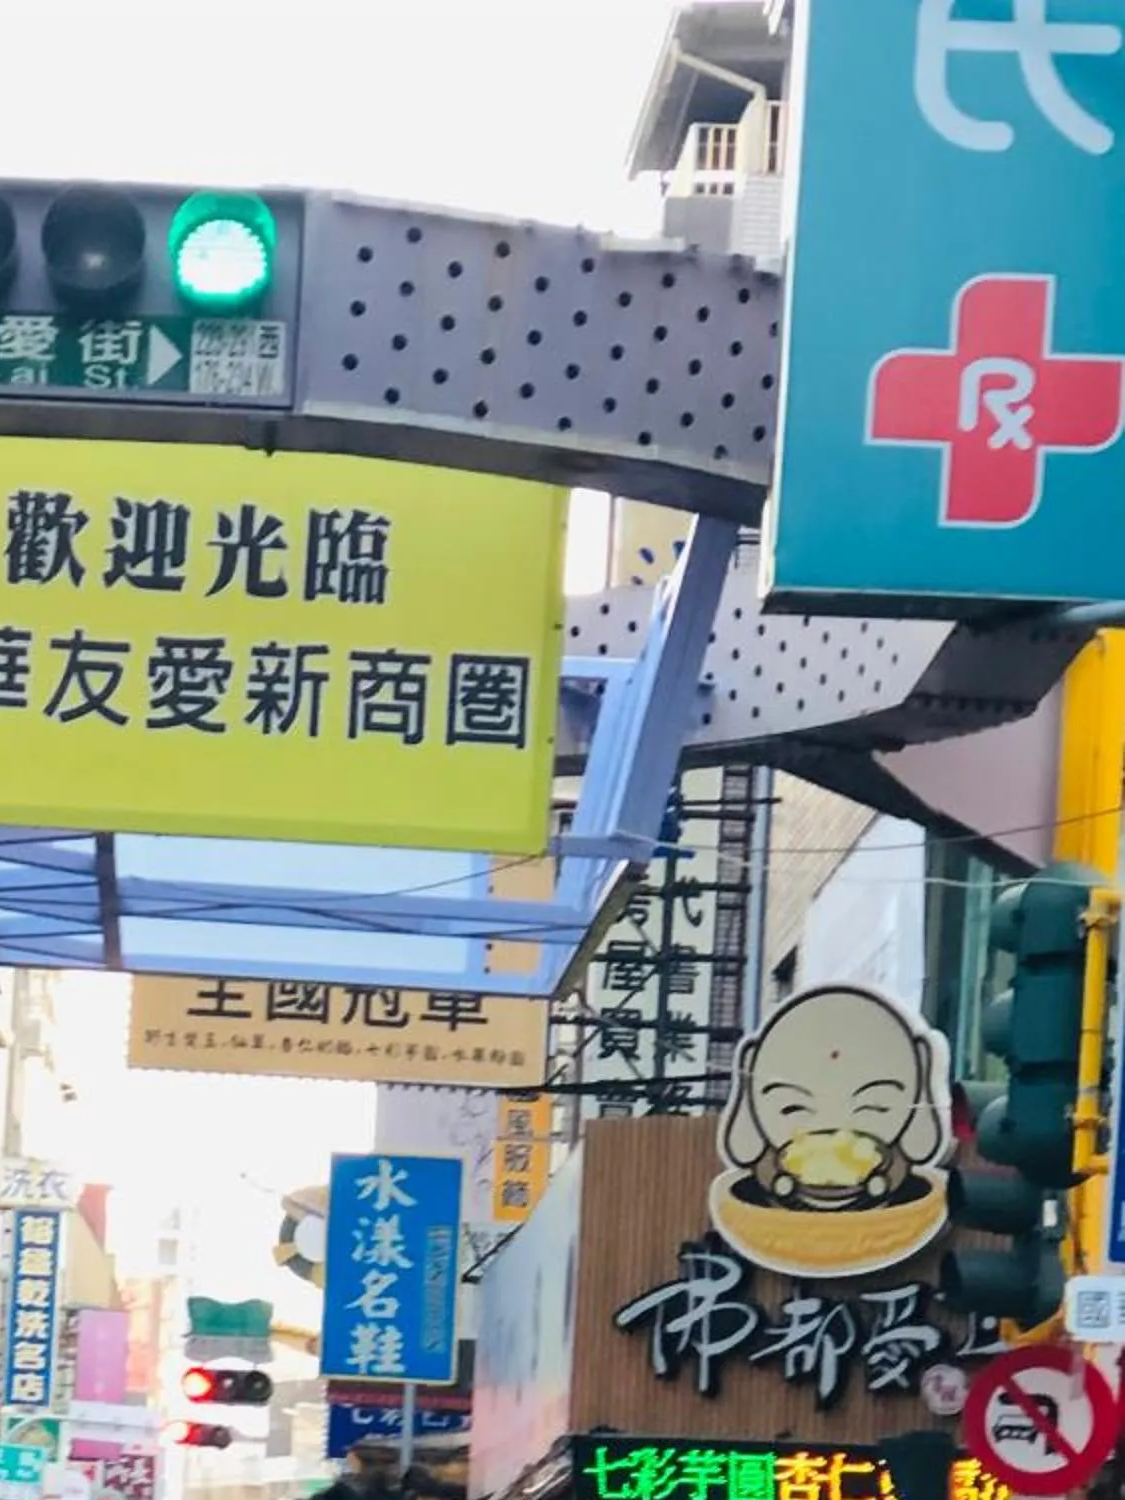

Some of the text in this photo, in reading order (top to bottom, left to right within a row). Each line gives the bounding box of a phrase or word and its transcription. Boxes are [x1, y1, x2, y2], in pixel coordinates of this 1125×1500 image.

[5, 489, 392, 605] 歡迎光臨
[345, 1160, 418, 1375] 水漾名鞋
